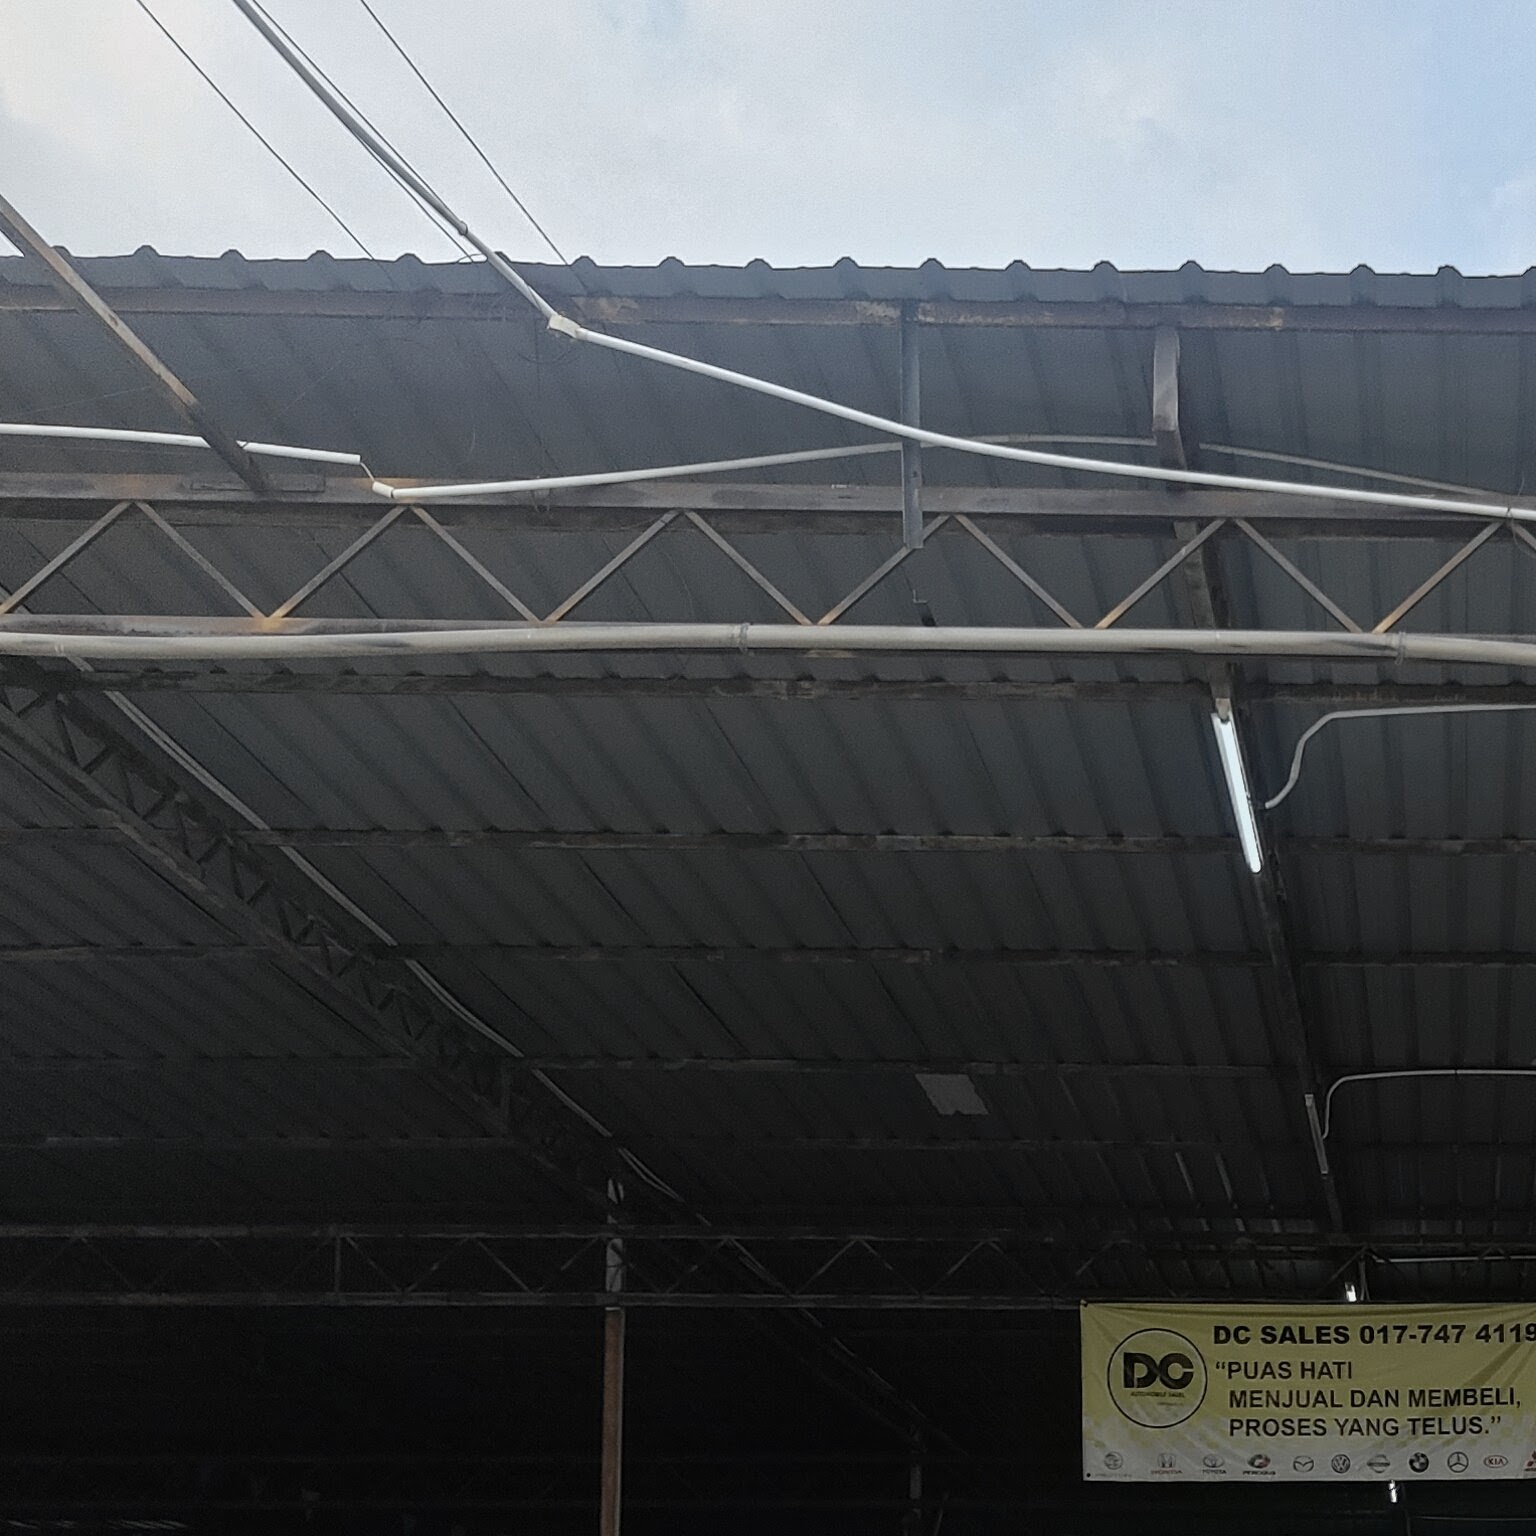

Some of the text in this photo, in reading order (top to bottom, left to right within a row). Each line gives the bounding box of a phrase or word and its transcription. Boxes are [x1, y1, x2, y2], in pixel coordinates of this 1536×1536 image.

[1213, 1325, 1251, 1345] DC
[1260, 1325, 1350, 1345] SALES
[1359, 1324, 1467, 1344] 017-747
[1123, 1351, 1194, 1390] DC
[1300, 1360, 1352, 1380] HATI
[1229, 1387, 1521, 1409] MENJUAL DAN MEMBELI,
[1229, 1418, 1327, 1437] PROSES
[1334, 1418, 1400, 1437] YANG
[1488, 1457, 1504, 1466] KIA
